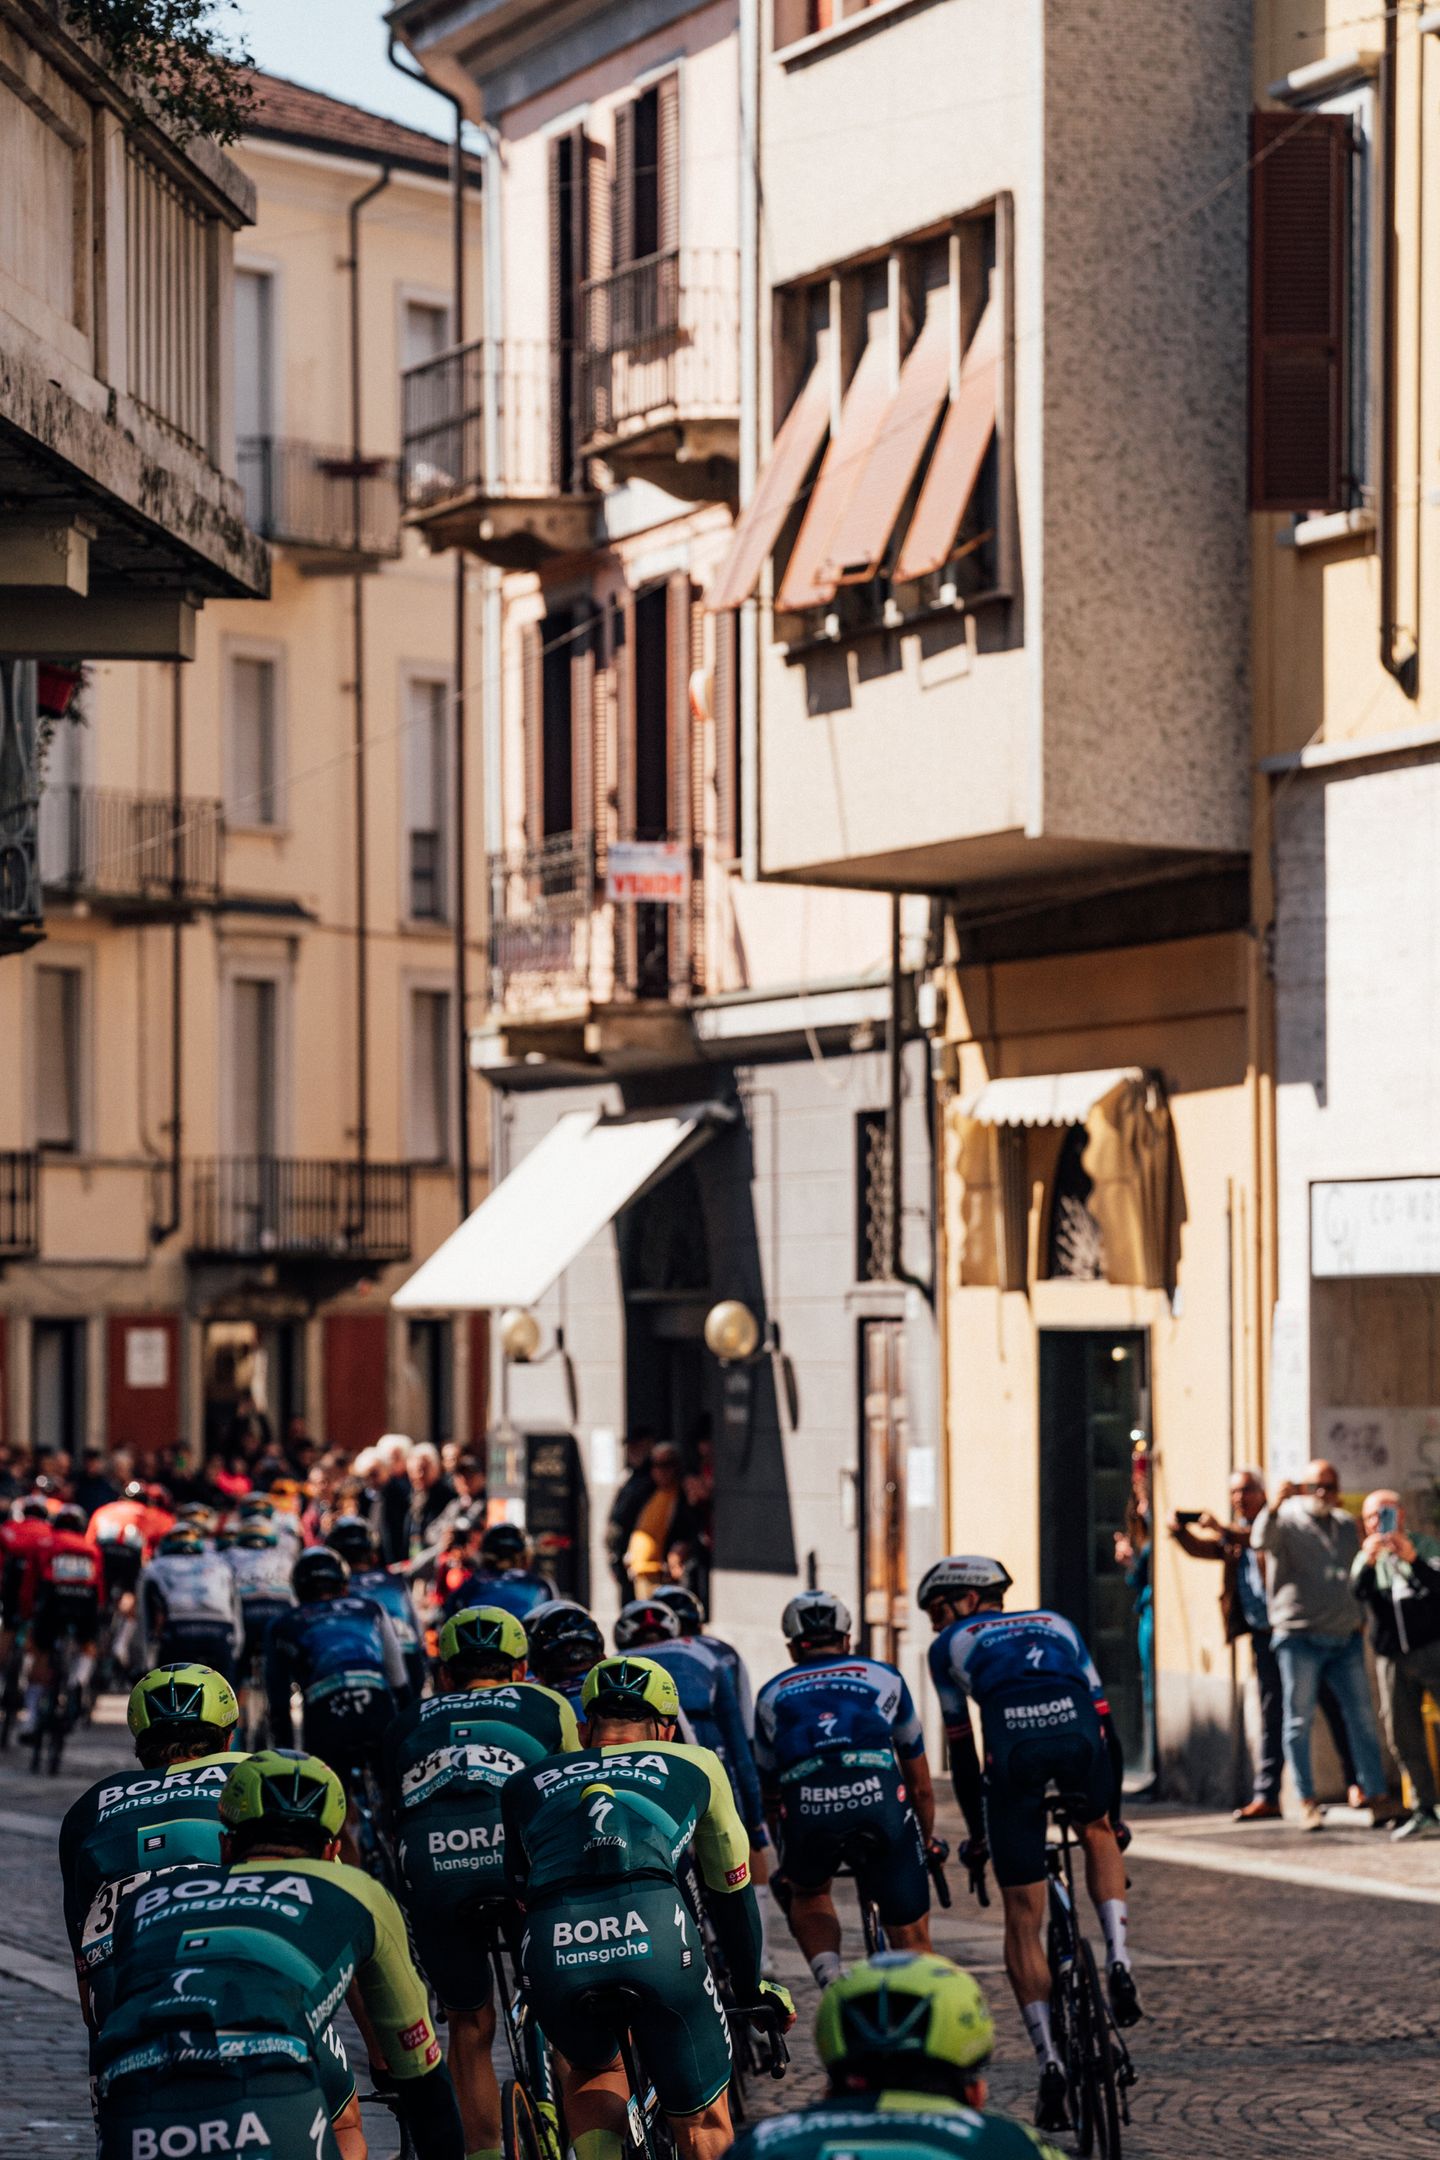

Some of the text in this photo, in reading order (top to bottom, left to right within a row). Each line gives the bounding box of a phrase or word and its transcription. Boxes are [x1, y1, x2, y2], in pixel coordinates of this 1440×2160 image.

[420, 1687, 521, 1714] BORA
[421, 1698, 517, 1722] hansgrohe
[1004, 1696, 1074, 1720] RENSON
[1006, 1710, 1078, 1730] OUTDOOR
[533, 1754, 669, 1791] BORA
[544, 1768, 662, 1798] hansgrohe
[98, 1766, 228, 1810] BORA
[800, 1775, 881, 1802] RENSON
[800, 1791, 883, 1815] OUTDOOR
[99, 1785, 223, 1822] hansgrohe
[428, 1823, 505, 1854] BORA
[432, 1849, 503, 1872] hansgroh
[134, 1875, 313, 1919] BORA
[136, 1895, 300, 1933] hansgrohe
[553, 1910, 648, 1947] BORA
[556, 1940, 649, 1967] hansgrohe
[132, 2111, 271, 2160] BORA
